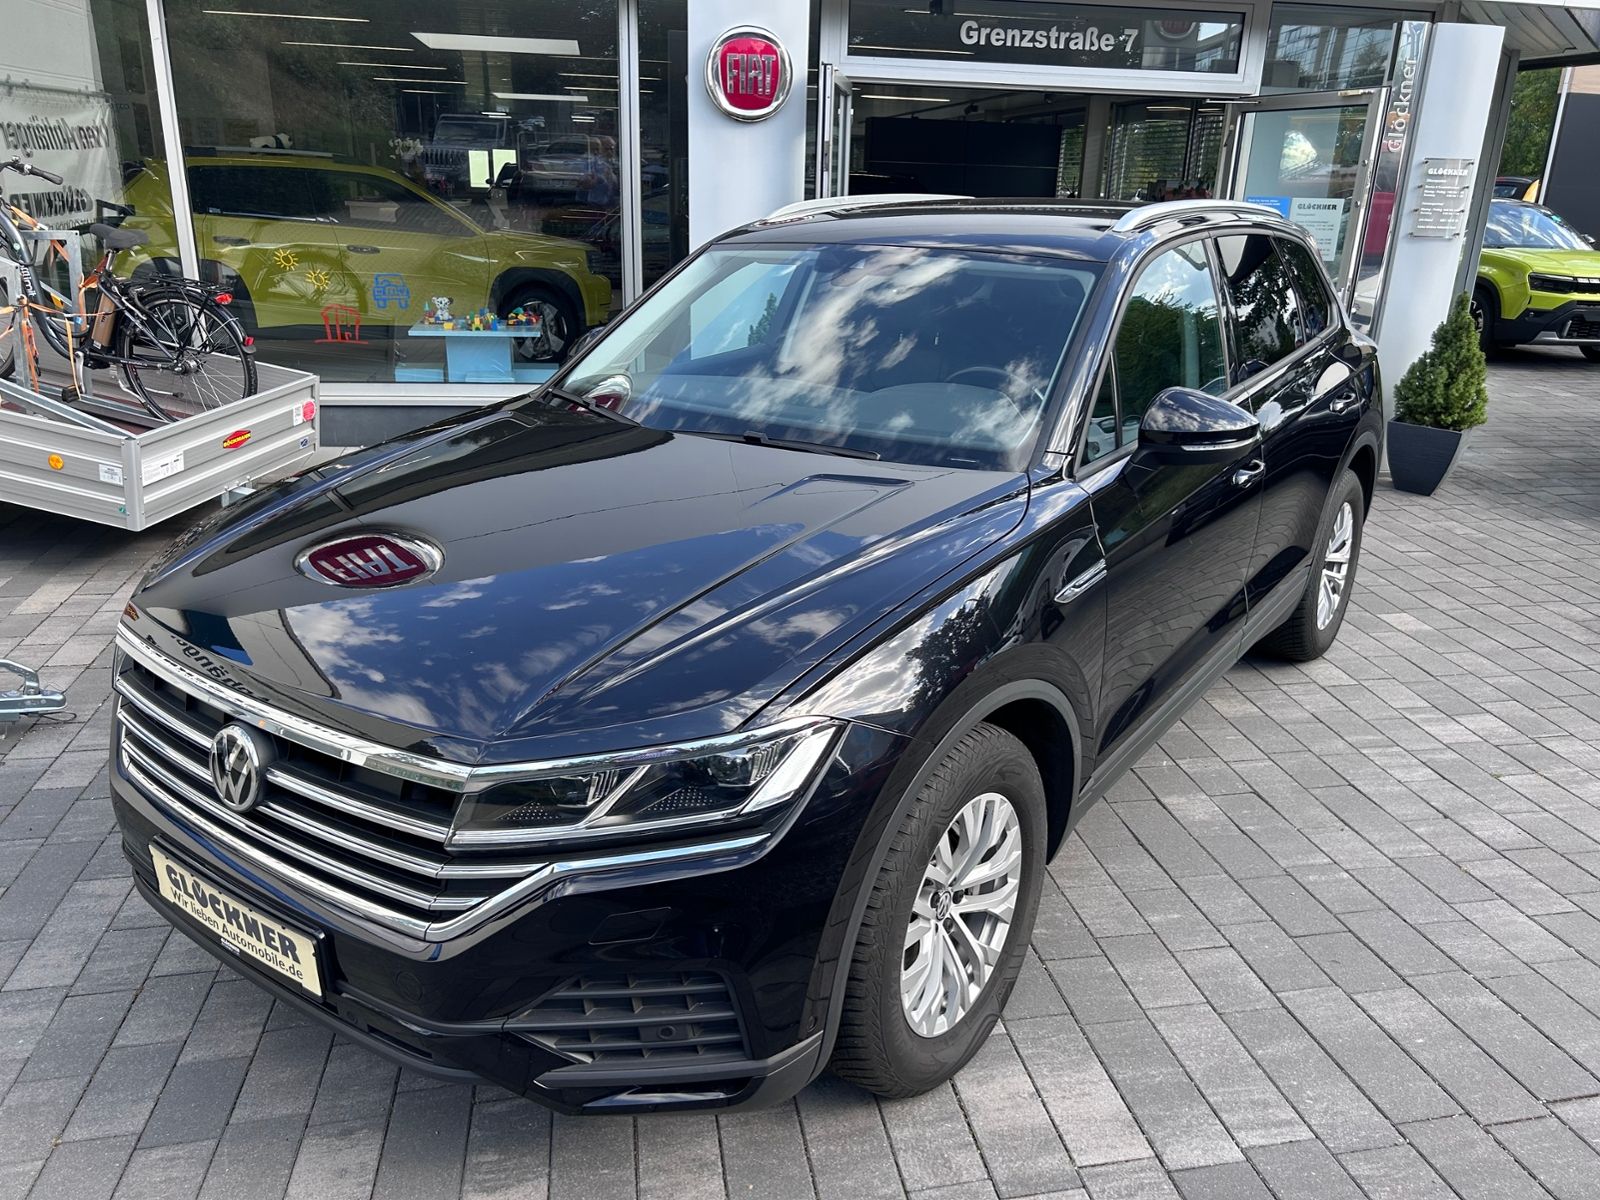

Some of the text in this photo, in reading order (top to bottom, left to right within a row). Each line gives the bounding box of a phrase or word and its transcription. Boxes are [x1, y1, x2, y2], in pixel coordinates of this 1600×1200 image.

[727, 53, 776, 95] FIAT
[960, 20, 1139, 52] Grenzstraße 7
[1387, 56, 1417, 153] Glöckner
[165, 864, 301, 965] GLÖCKNER
[170, 887, 189, 908] Wir
[191, 903, 220, 931] lieben
[222, 925, 303, 980] Automobile.de
